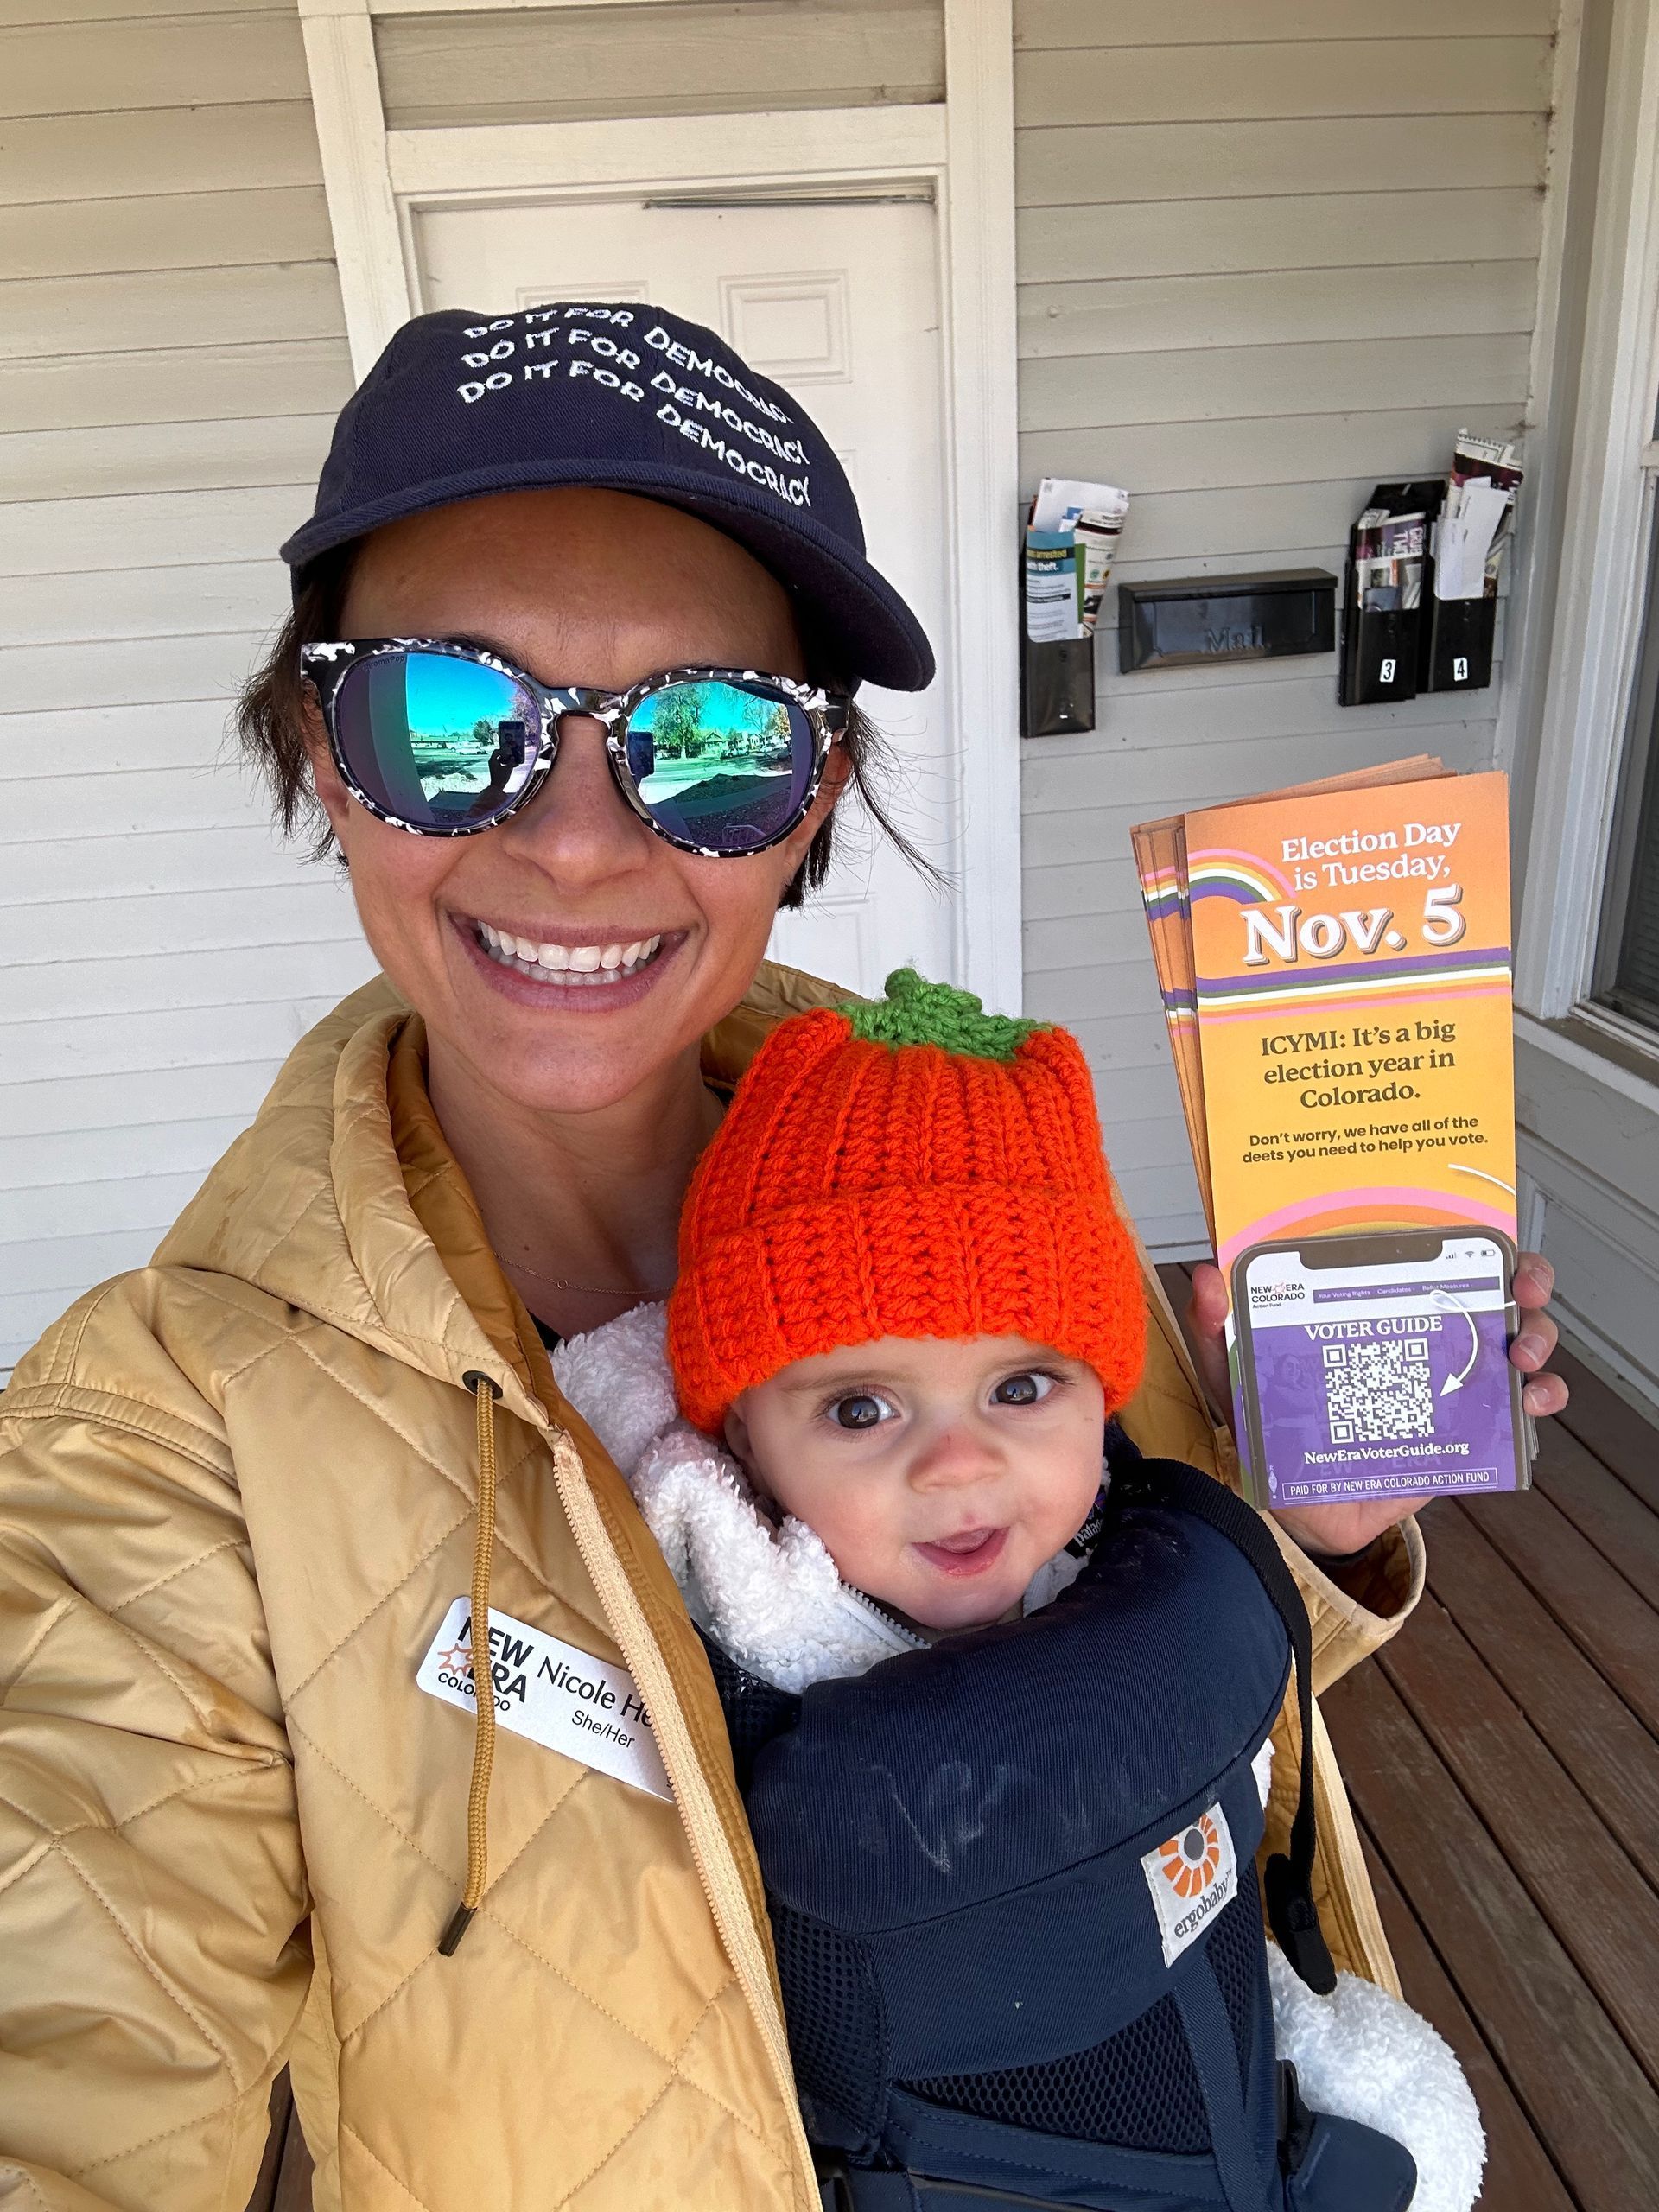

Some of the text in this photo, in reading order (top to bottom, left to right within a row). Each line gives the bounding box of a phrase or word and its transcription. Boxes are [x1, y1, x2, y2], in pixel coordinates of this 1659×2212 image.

[463, 319, 514, 338] DO
[525, 309, 558, 324] IT
[564, 308, 634, 327] FOR
[461, 327, 810, 465] DO IT FOR DEMOCRACY
[457, 360, 810, 506] DO IT FOR DEMOCRACY
[1383, 661, 1392, 680] 3
[1457, 659, 1465, 677] 4
[1281, 822, 1461, 862] Election Day
[1294, 852, 1451, 892] is Tuesday,
[1239, 882, 1467, 966] Nov. 5
[1261, 1020, 1456, 1057] ICYMI: It's a big
[1263, 1050, 1456, 1084] election year in
[1300, 1082, 1421, 1109] Colorado.
[1249, 1116, 1478, 1147] Don't worry, we have all of the
[1243, 1132, 1489, 1163] deets you need to help you vote.
[1250, 1283, 1305, 1294] NEW ERA
[1251, 1292, 1306, 1303] COLORADO
[1352, 1289, 1370, 1298] Rights
[1377, 1287, 1412, 1295] Candidates
[1304, 1316, 1442, 1340] VOTER GUIDE
[1304, 1443, 1470, 1465] NewEraVoterGuide.org
[1291, 1471, 1490, 1496] PAID FOR BY NEW ERA COLORADO ACTION FUND
[438, 1672, 510, 1711] COLODO
[537, 1656, 615, 1710] Nicole
[571, 1710, 635, 1749] She/Her
